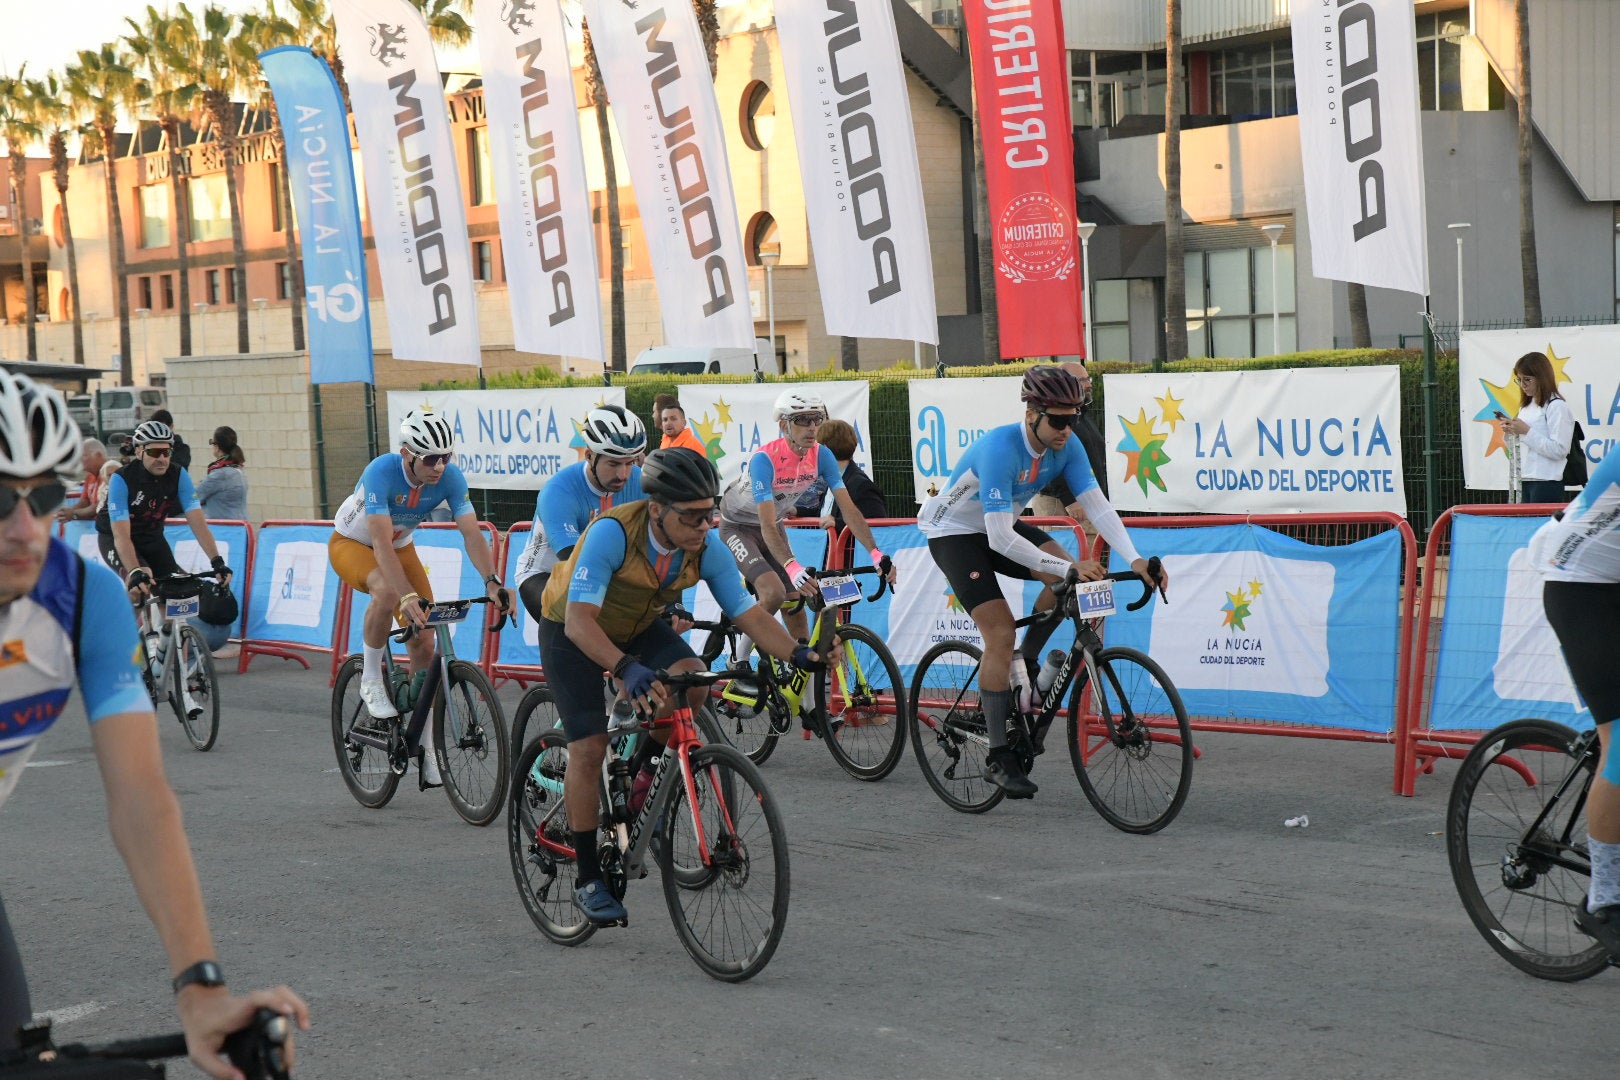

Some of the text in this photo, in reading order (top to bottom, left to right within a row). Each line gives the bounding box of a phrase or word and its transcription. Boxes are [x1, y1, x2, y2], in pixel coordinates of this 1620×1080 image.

[1195, 419, 1232, 458] LA
[486, 455, 506, 475] DEL
[1196, 469, 1394, 492] CIUDAD DEL DEPORTE
[726, 534, 749, 562] MRB
[834, 585, 840, 595] 7
[1086, 591, 1112, 607] 1119
[936, 620, 945, 630] LA
[1207, 638, 1219, 650] LA
[1200, 655, 1223, 664] CIUDAD
[1236, 656, 1265, 666] DEPORTE
[628, 753, 672, 851] BOTTECCHIA
